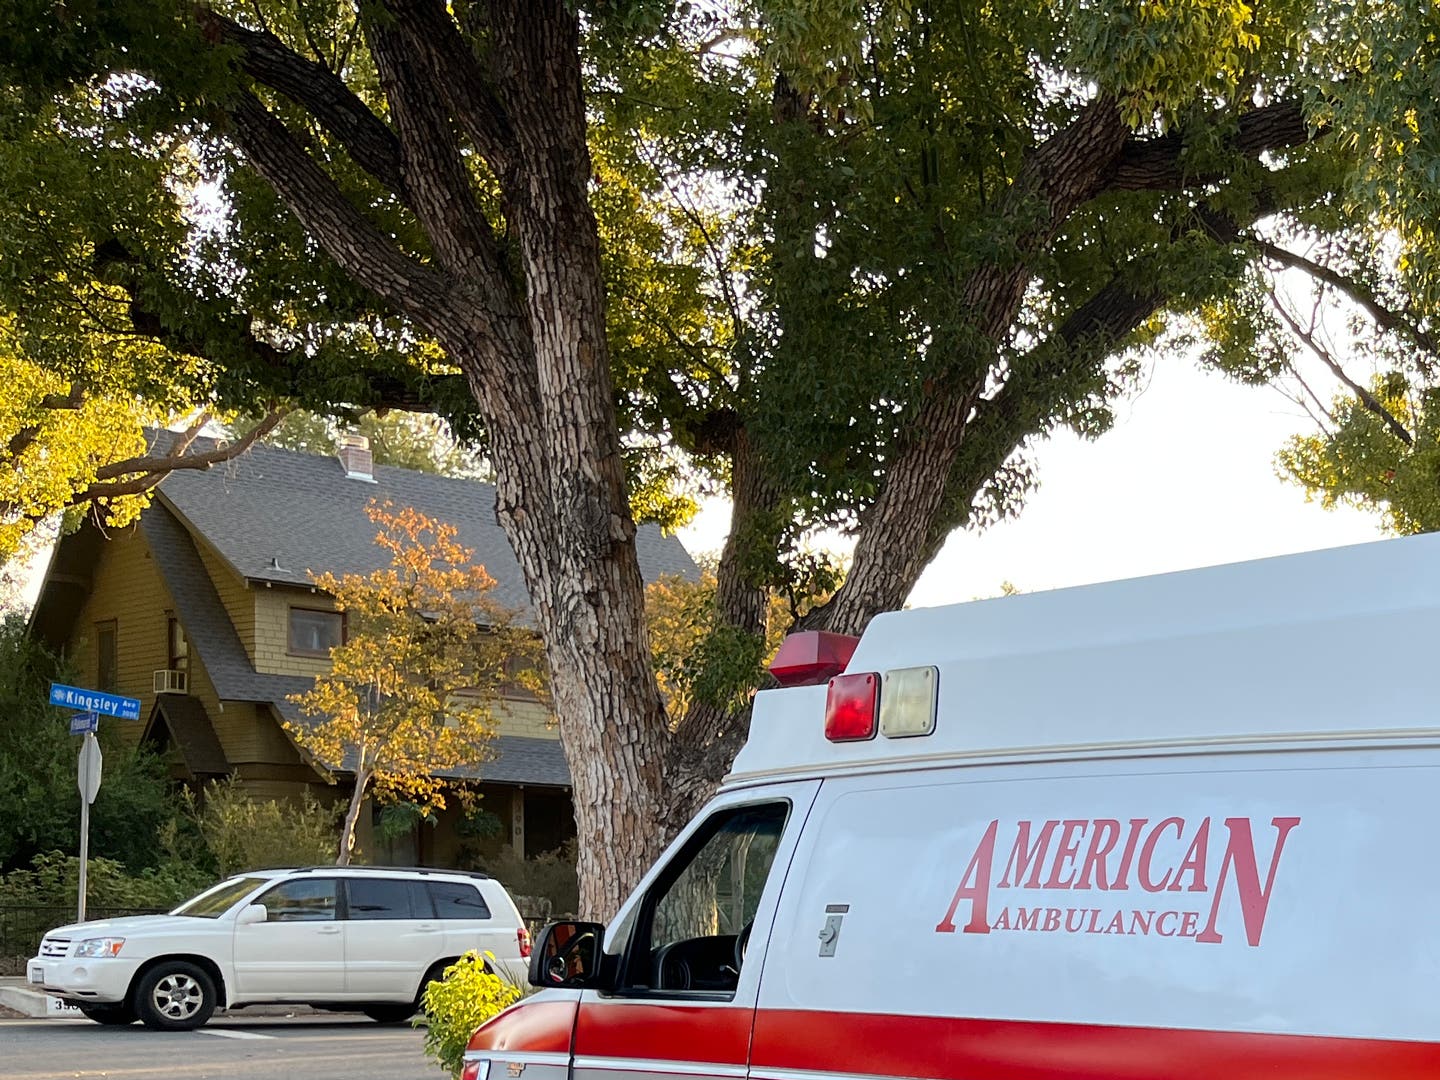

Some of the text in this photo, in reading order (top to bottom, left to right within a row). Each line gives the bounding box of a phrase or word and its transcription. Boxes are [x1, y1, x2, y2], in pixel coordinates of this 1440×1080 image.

[66, 691, 118, 715] Kingsley
[935, 816, 1301, 947] AMERICAN
[990, 906, 1199, 938] AMBULANCE
